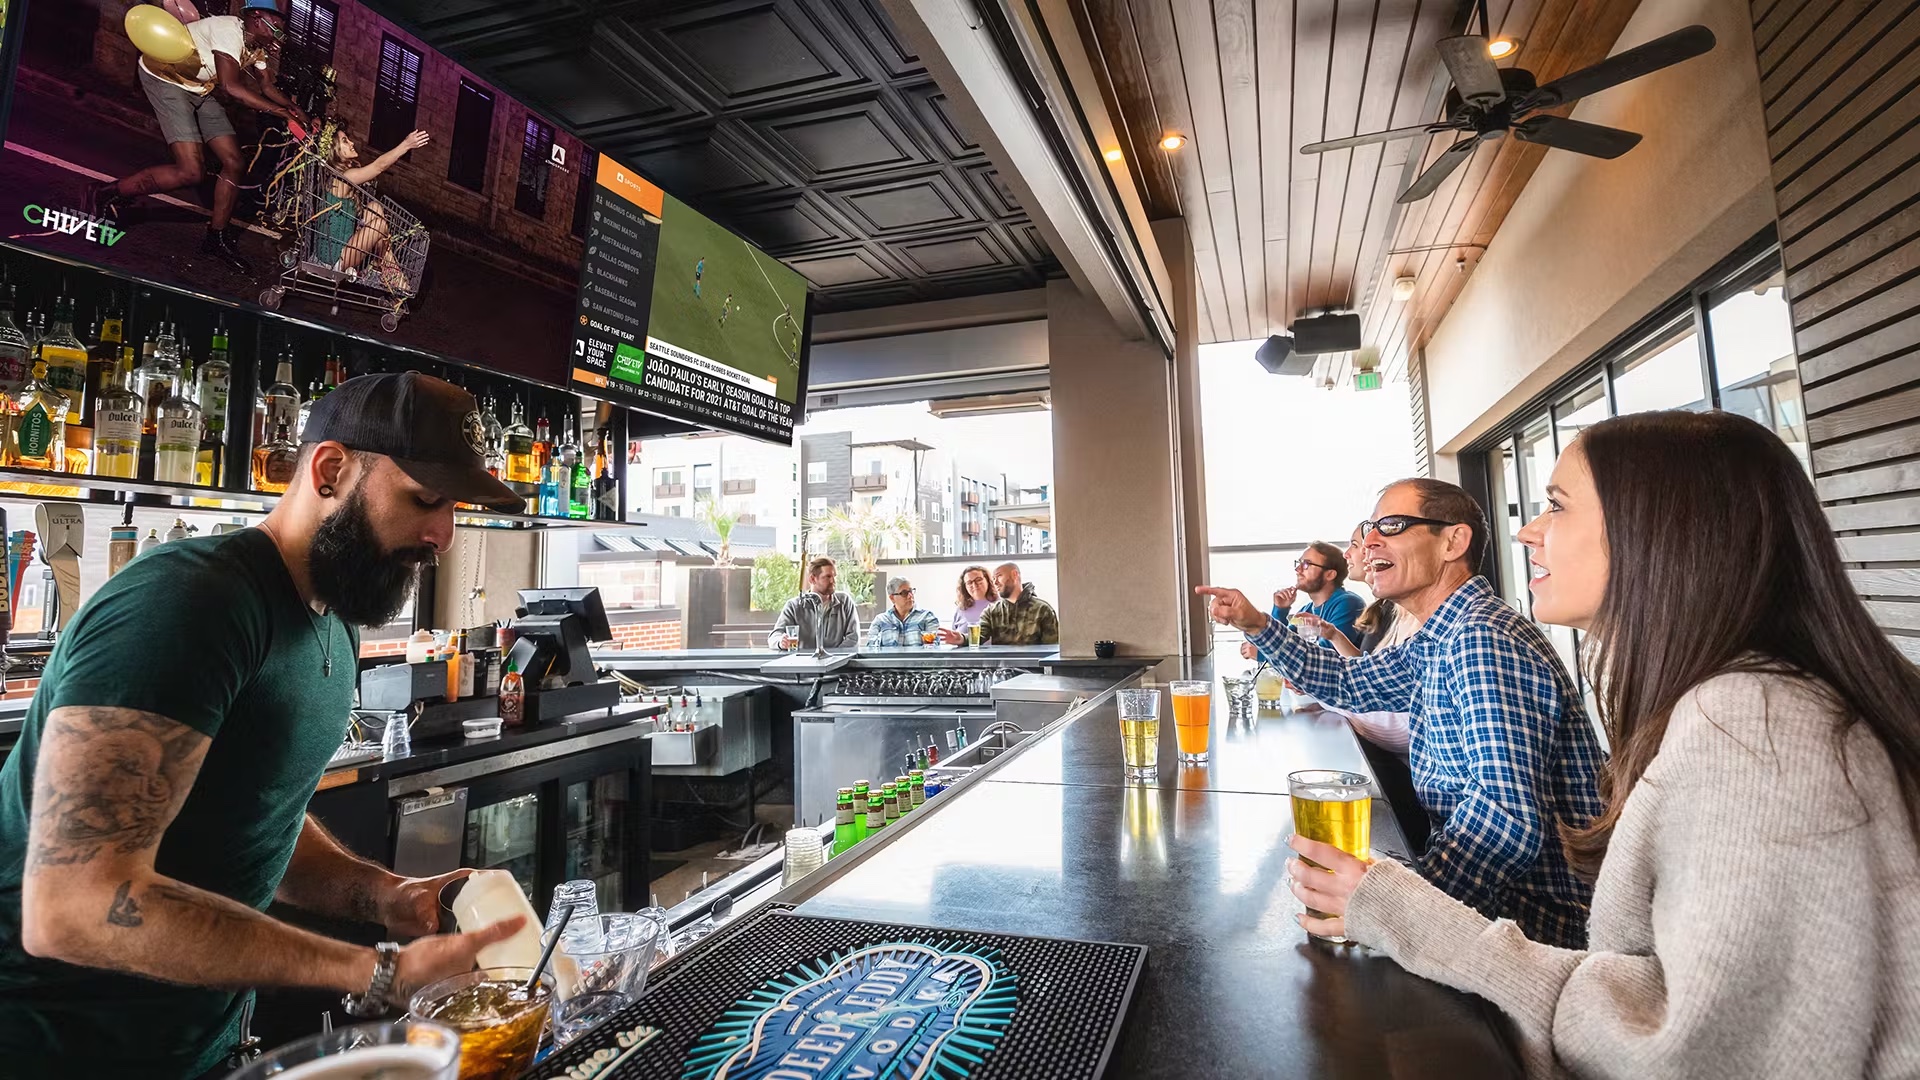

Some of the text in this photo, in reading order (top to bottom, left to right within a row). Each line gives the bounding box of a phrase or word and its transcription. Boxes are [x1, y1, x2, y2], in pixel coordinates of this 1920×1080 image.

[624, 178, 641, 192] SPORTS
[606, 200, 646, 226] MAGNUS CARLSEN
[603, 217, 638, 239] BOXING MATCH
[601, 234, 642, 259] AUSTRALIAN OPEN
[599, 252, 639, 275] DALLAS COWBOYS
[597, 268, 628, 287] BLACKHAWKS
[594, 285, 637, 308] BASEBALL SEASON
[592, 302, 639, 326] SAN ANTONIO SPURS
[590, 320, 603, 330] GOAL
[611, 327, 620, 336] THE
[621, 331, 635, 341] YEAR?
[588, 347, 604, 359] YOUR
[589, 338, 614, 353] ELEVATE
[586, 356, 606, 368] SPACE
[649, 342, 669, 355] SEATTLE
[670, 350, 693, 363] SOUNDERS
[700, 360, 710, 370] STAR
[711, 364, 726, 375] SCORES
[727, 370, 740, 380] ROCKET
[741, 375, 750, 384] GOAL
[595, 377, 604, 385] NFL
[647, 359, 791, 414] JOÃO PAULO'S EARLY SEASON GOAL IS A TOP
[645, 373, 793, 427] CANDIDATE FOR 2021 AT&T GOAL OF THE YEAR
[108, 412, 132, 422] Dulce
[171, 420, 192, 429] Dulce
[29, 412, 42, 454] HORNITOS
[762, 1023, 856, 1080] DEEP
[841, 958, 920, 1010] EDDY
[546, 1025, 655, 1080] ive in
